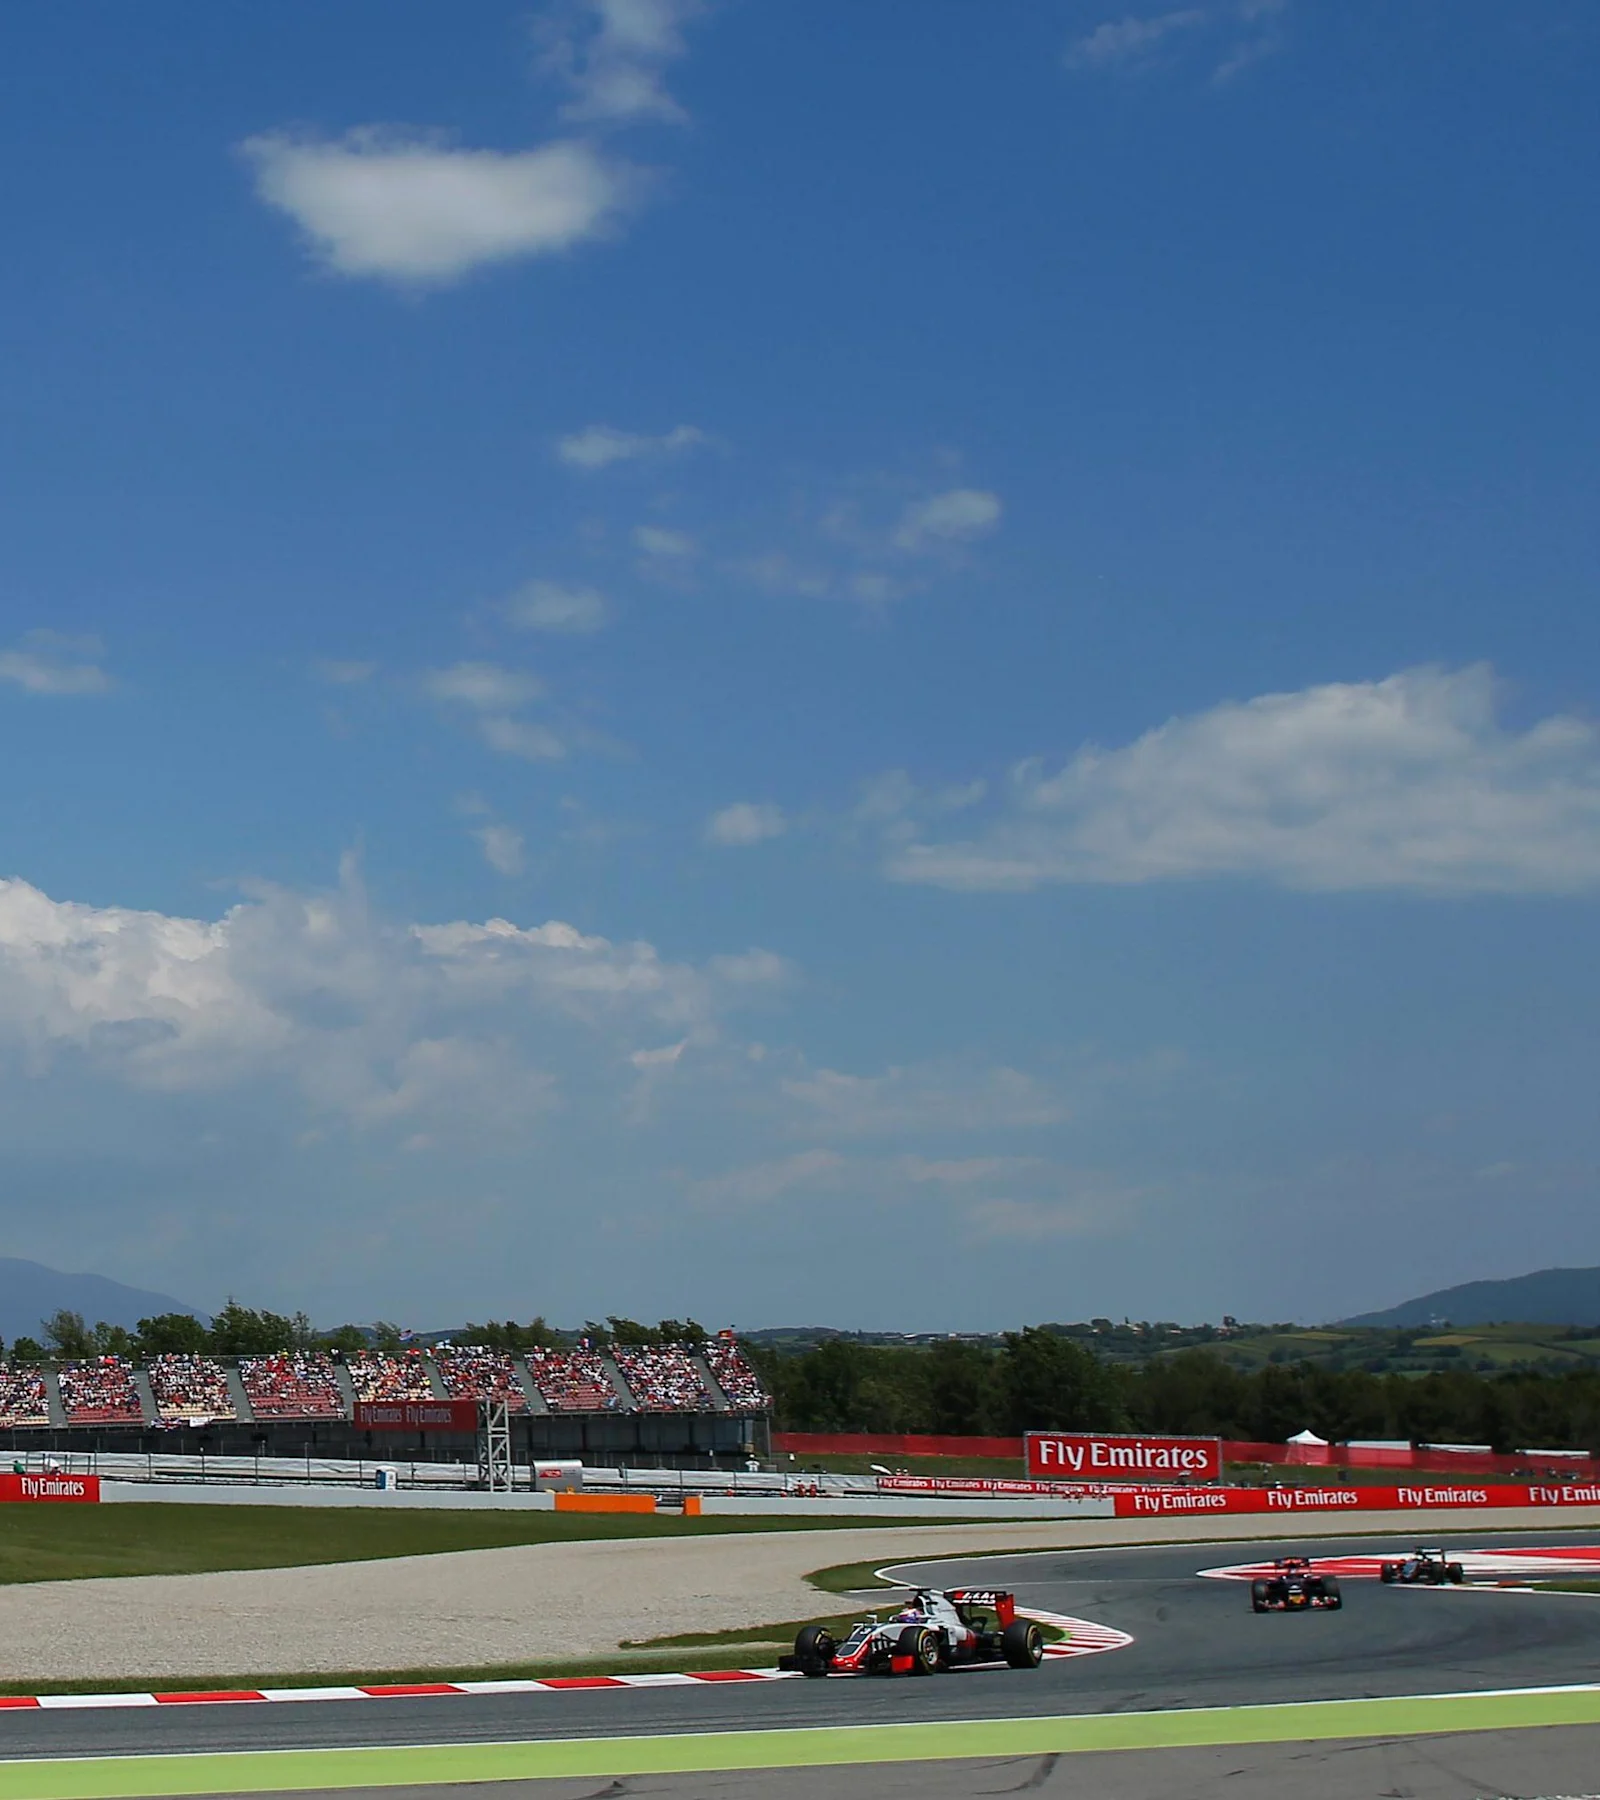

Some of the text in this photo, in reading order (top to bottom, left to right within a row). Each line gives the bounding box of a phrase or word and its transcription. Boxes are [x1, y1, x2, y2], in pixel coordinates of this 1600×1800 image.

[1039, 1440, 1208, 1471] Fly Emirates
[21, 1477, 84, 1498] Fly Emirates
[1398, 1487, 1487, 1505] Fly Emirates
[1529, 1486, 1558, 1505] Fly
[1135, 1493, 1226, 1512] Fly Emirates
[1267, 1488, 1357, 1509] Fly Emirates
